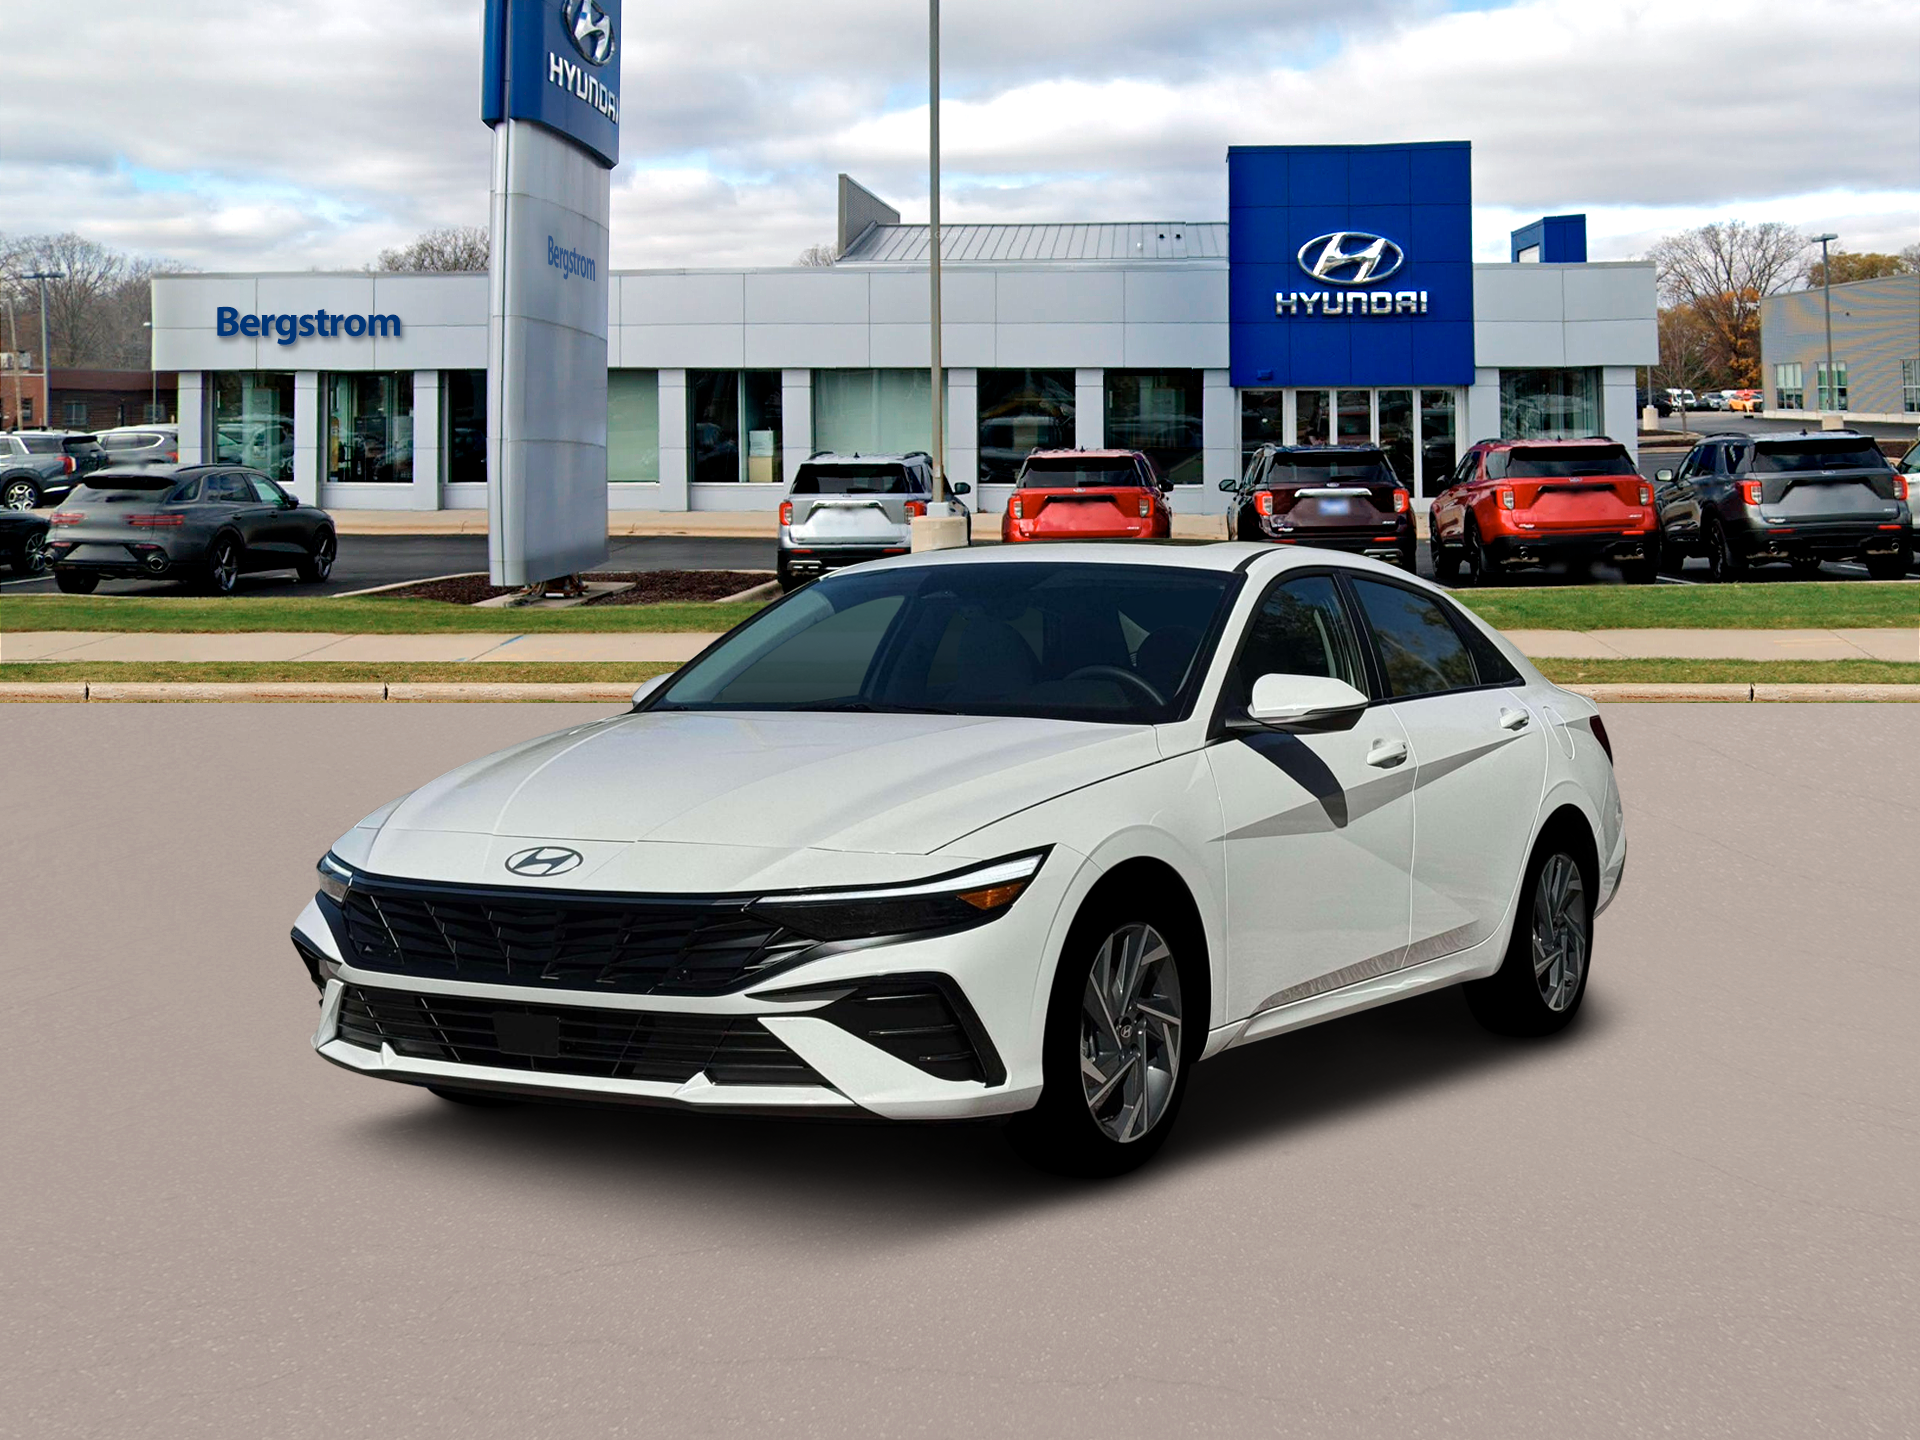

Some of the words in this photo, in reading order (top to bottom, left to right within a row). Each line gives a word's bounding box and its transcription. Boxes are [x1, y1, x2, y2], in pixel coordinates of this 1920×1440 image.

[549, 52, 619, 124] HYUNDAI
[547, 234, 596, 282] Bergstrom
[1275, 291, 1428, 315] HYUNDAI
[216, 306, 401, 346] Bergstrom
